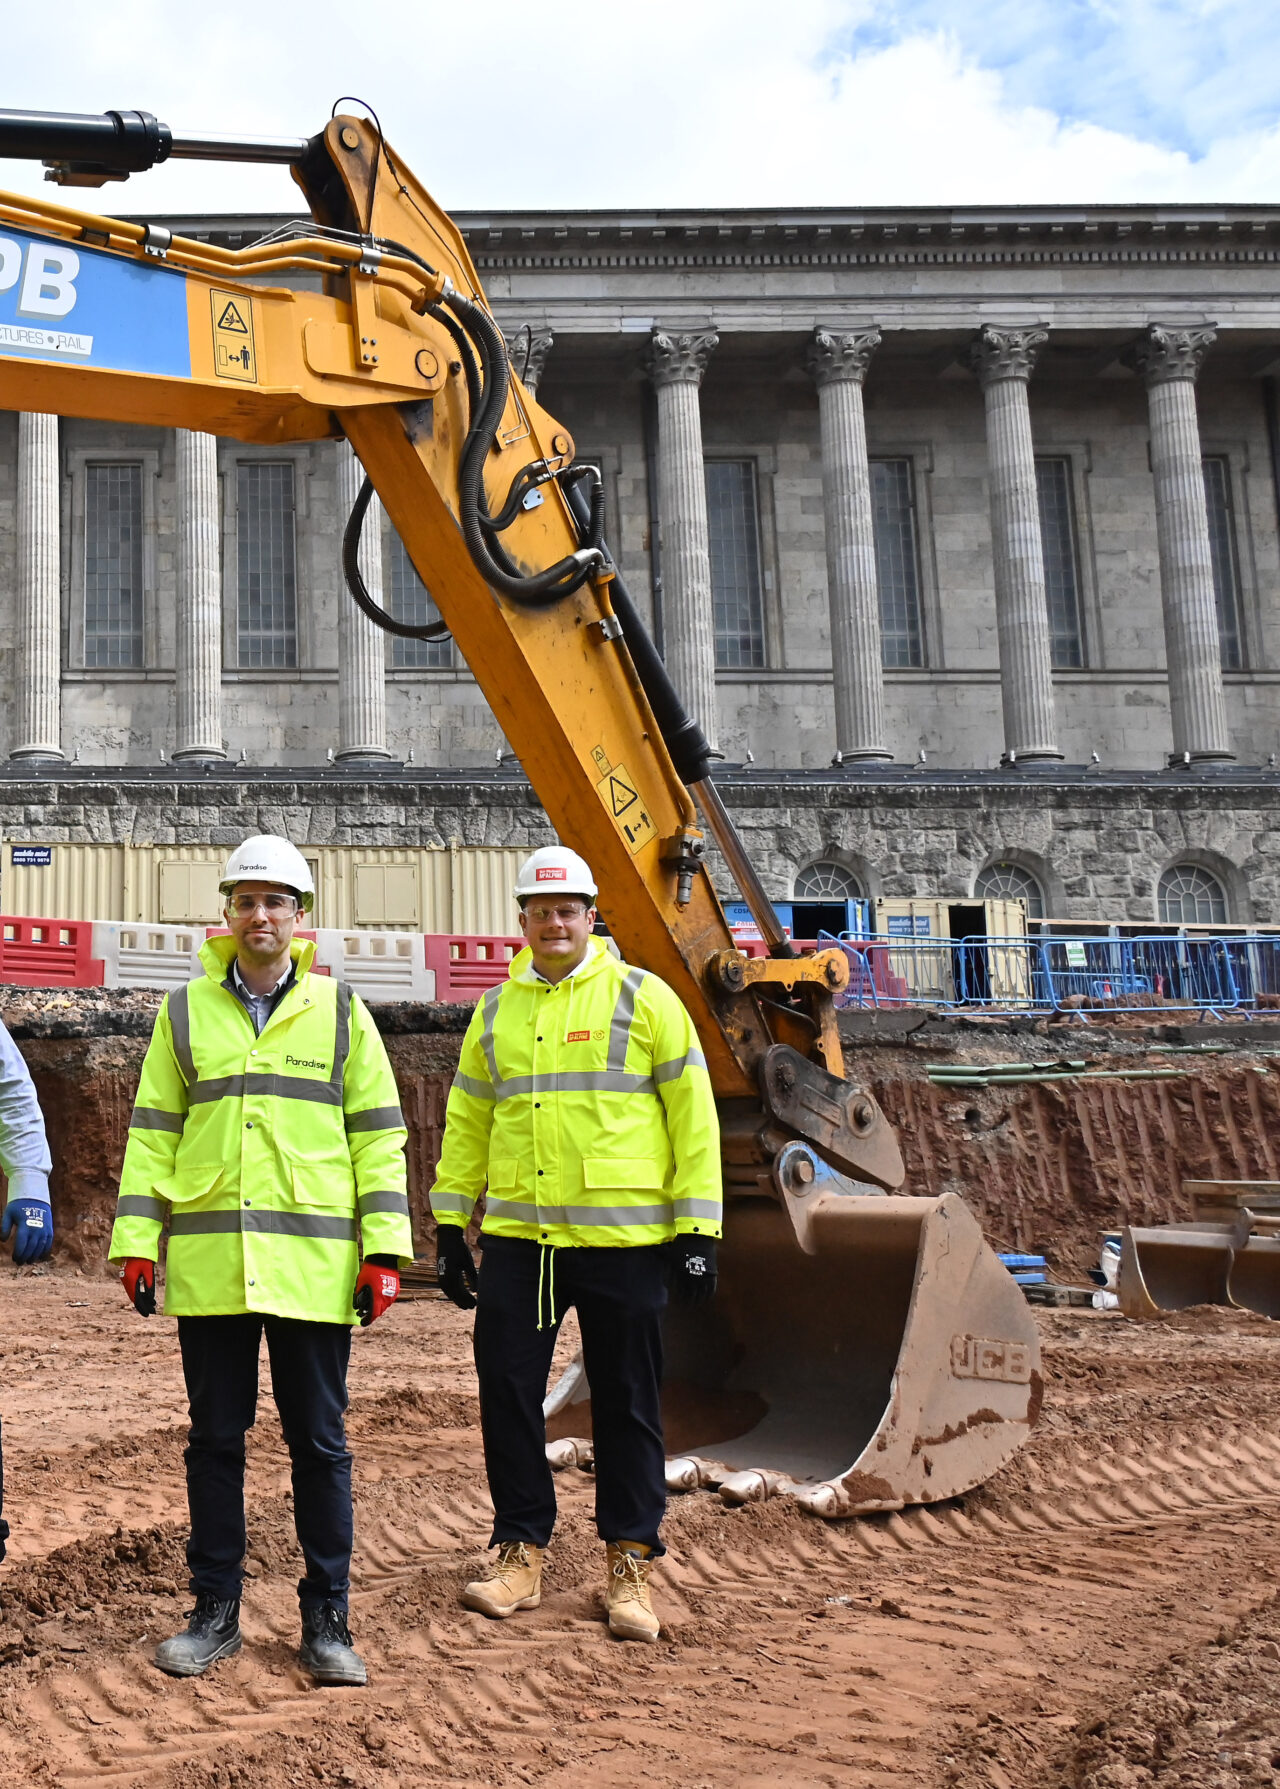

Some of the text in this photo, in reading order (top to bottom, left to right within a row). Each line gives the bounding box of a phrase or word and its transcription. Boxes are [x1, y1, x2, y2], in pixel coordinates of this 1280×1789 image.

[57, 334, 86, 351] RAIL
[238, 863, 268, 871] Paradise
[285, 1055, 326, 1070] Paradise
